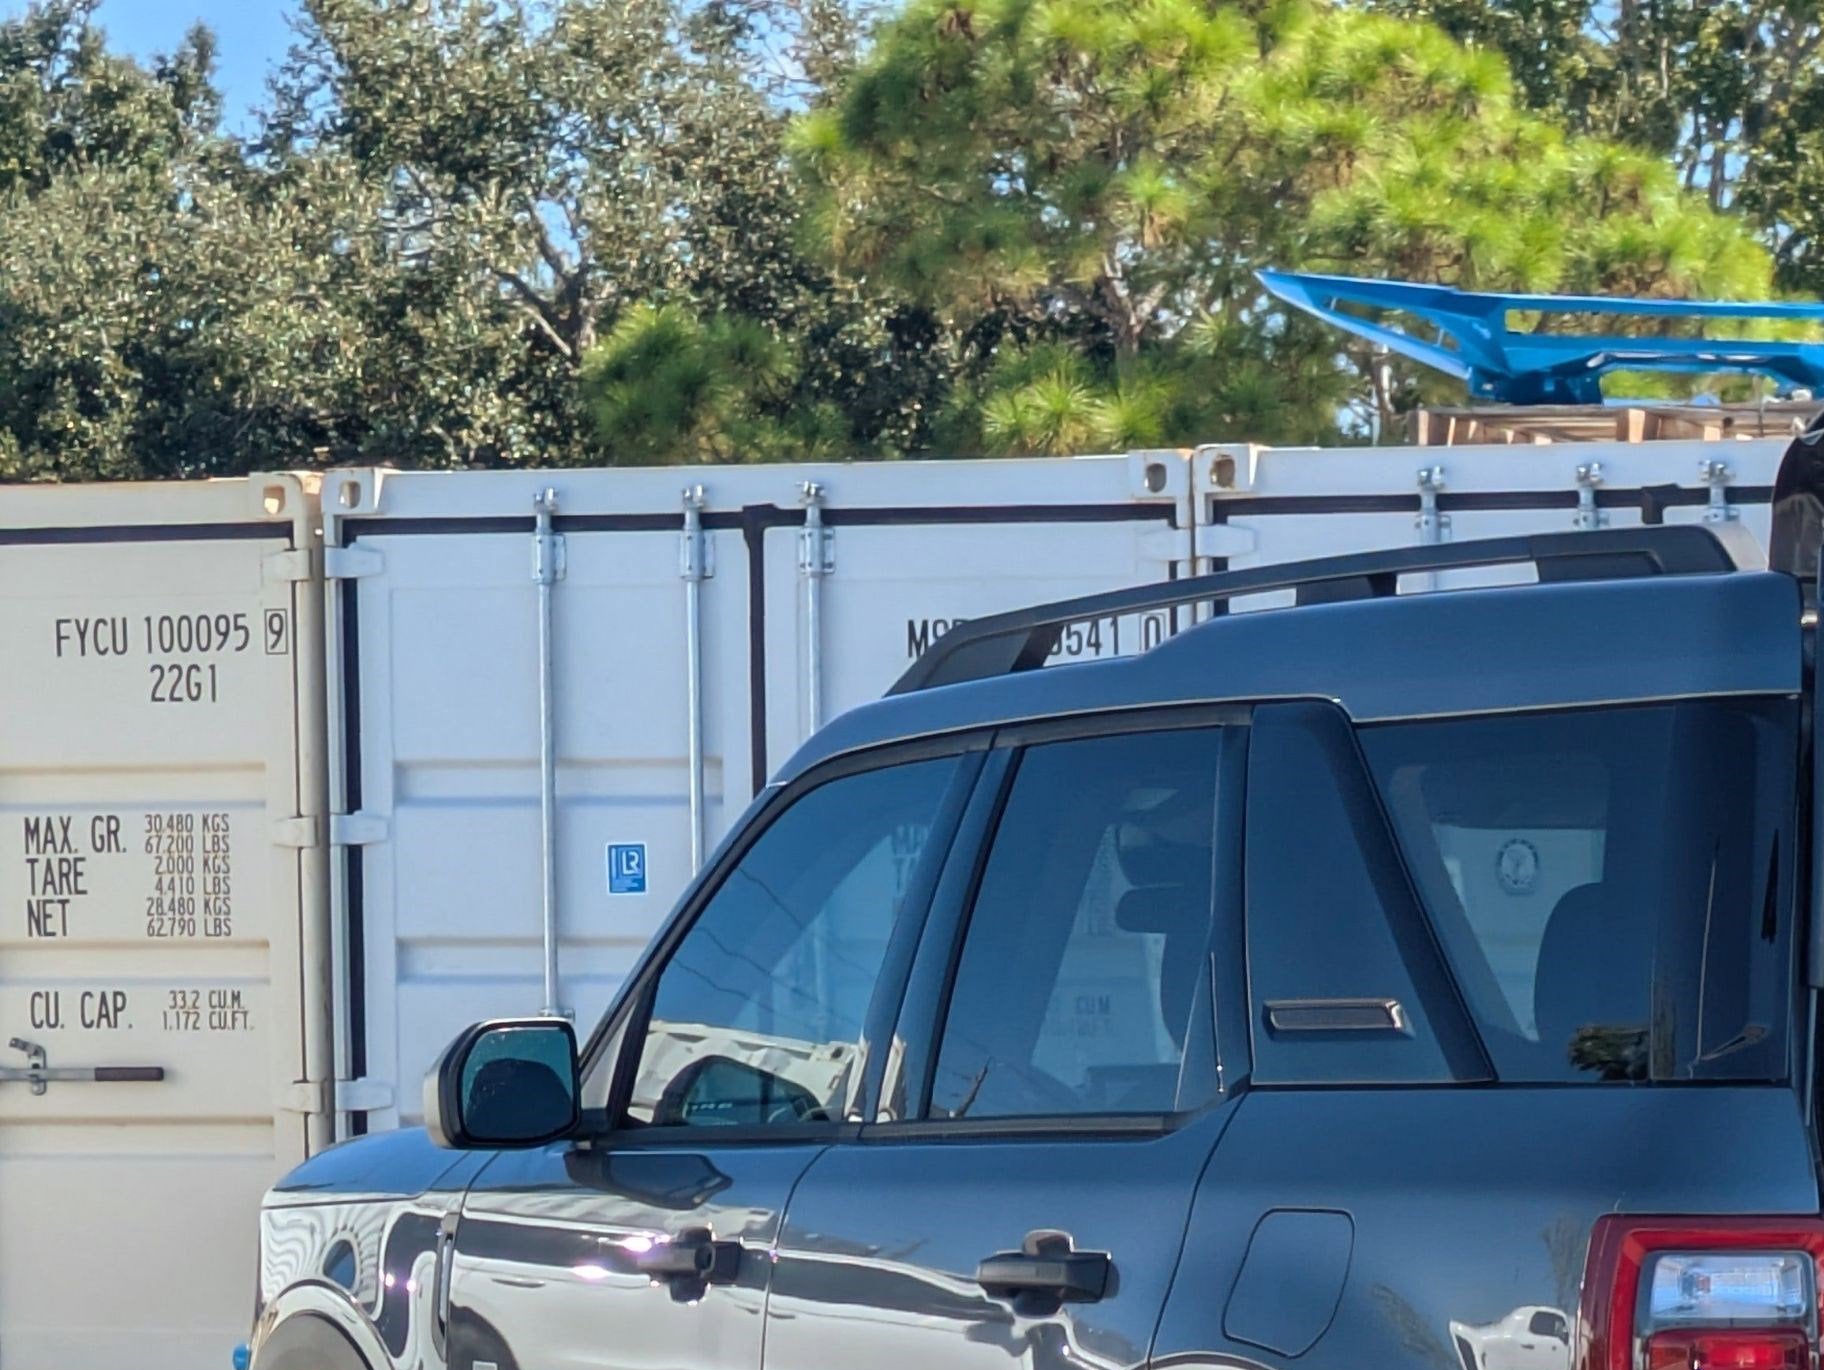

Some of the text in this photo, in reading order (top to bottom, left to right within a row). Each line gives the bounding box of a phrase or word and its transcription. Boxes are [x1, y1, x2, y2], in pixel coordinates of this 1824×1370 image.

[55, 612, 285, 658] FYCU 100095 9
[149, 663, 217, 703] 22G1
[201, 813, 230, 833] KGS
[24, 814, 127, 855] MAX. GR.
[202, 833, 230, 855] LBS
[202, 854, 231, 875] KGS
[25, 856, 88, 896] TARE
[202, 875, 231, 896] LBS
[203, 896, 231, 917] KGS
[26, 898, 71, 938] NET
[203, 917, 232, 938] LBS
[30, 990, 134, 1030] CU. CAP.
[168, 989, 201, 1010] 33.2
